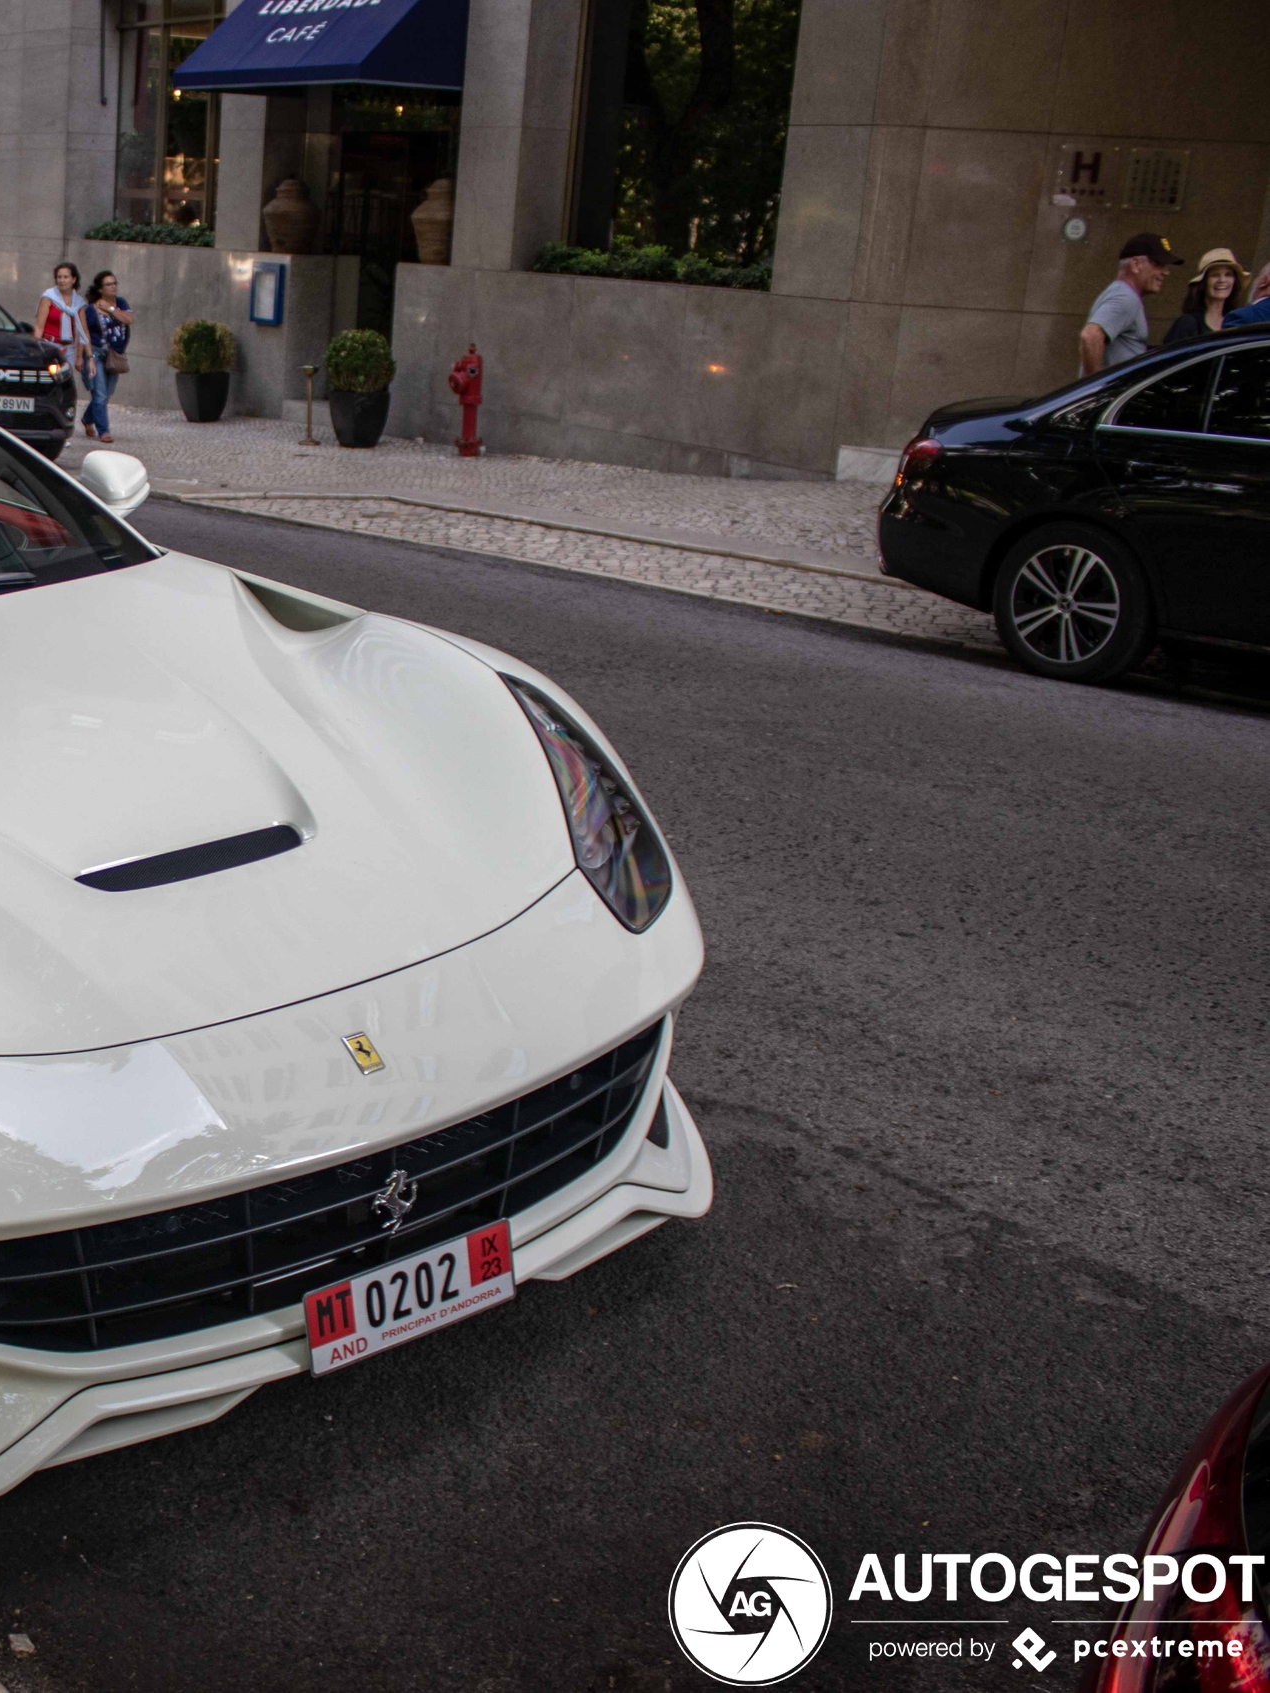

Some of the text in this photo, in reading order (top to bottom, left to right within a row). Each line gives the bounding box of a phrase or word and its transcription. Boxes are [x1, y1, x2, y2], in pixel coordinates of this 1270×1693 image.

[266, 21, 328, 43] CAFÉ
[1071, 151, 1102, 184] H
[481, 1233, 498, 1257] IX
[482, 1257, 502, 1281] 23
[316, 1252, 459, 1338] MT 0202
[381, 1286, 502, 1341] PRINCIPAT D'ANDORRA
[330, 1337, 368, 1364] AND
